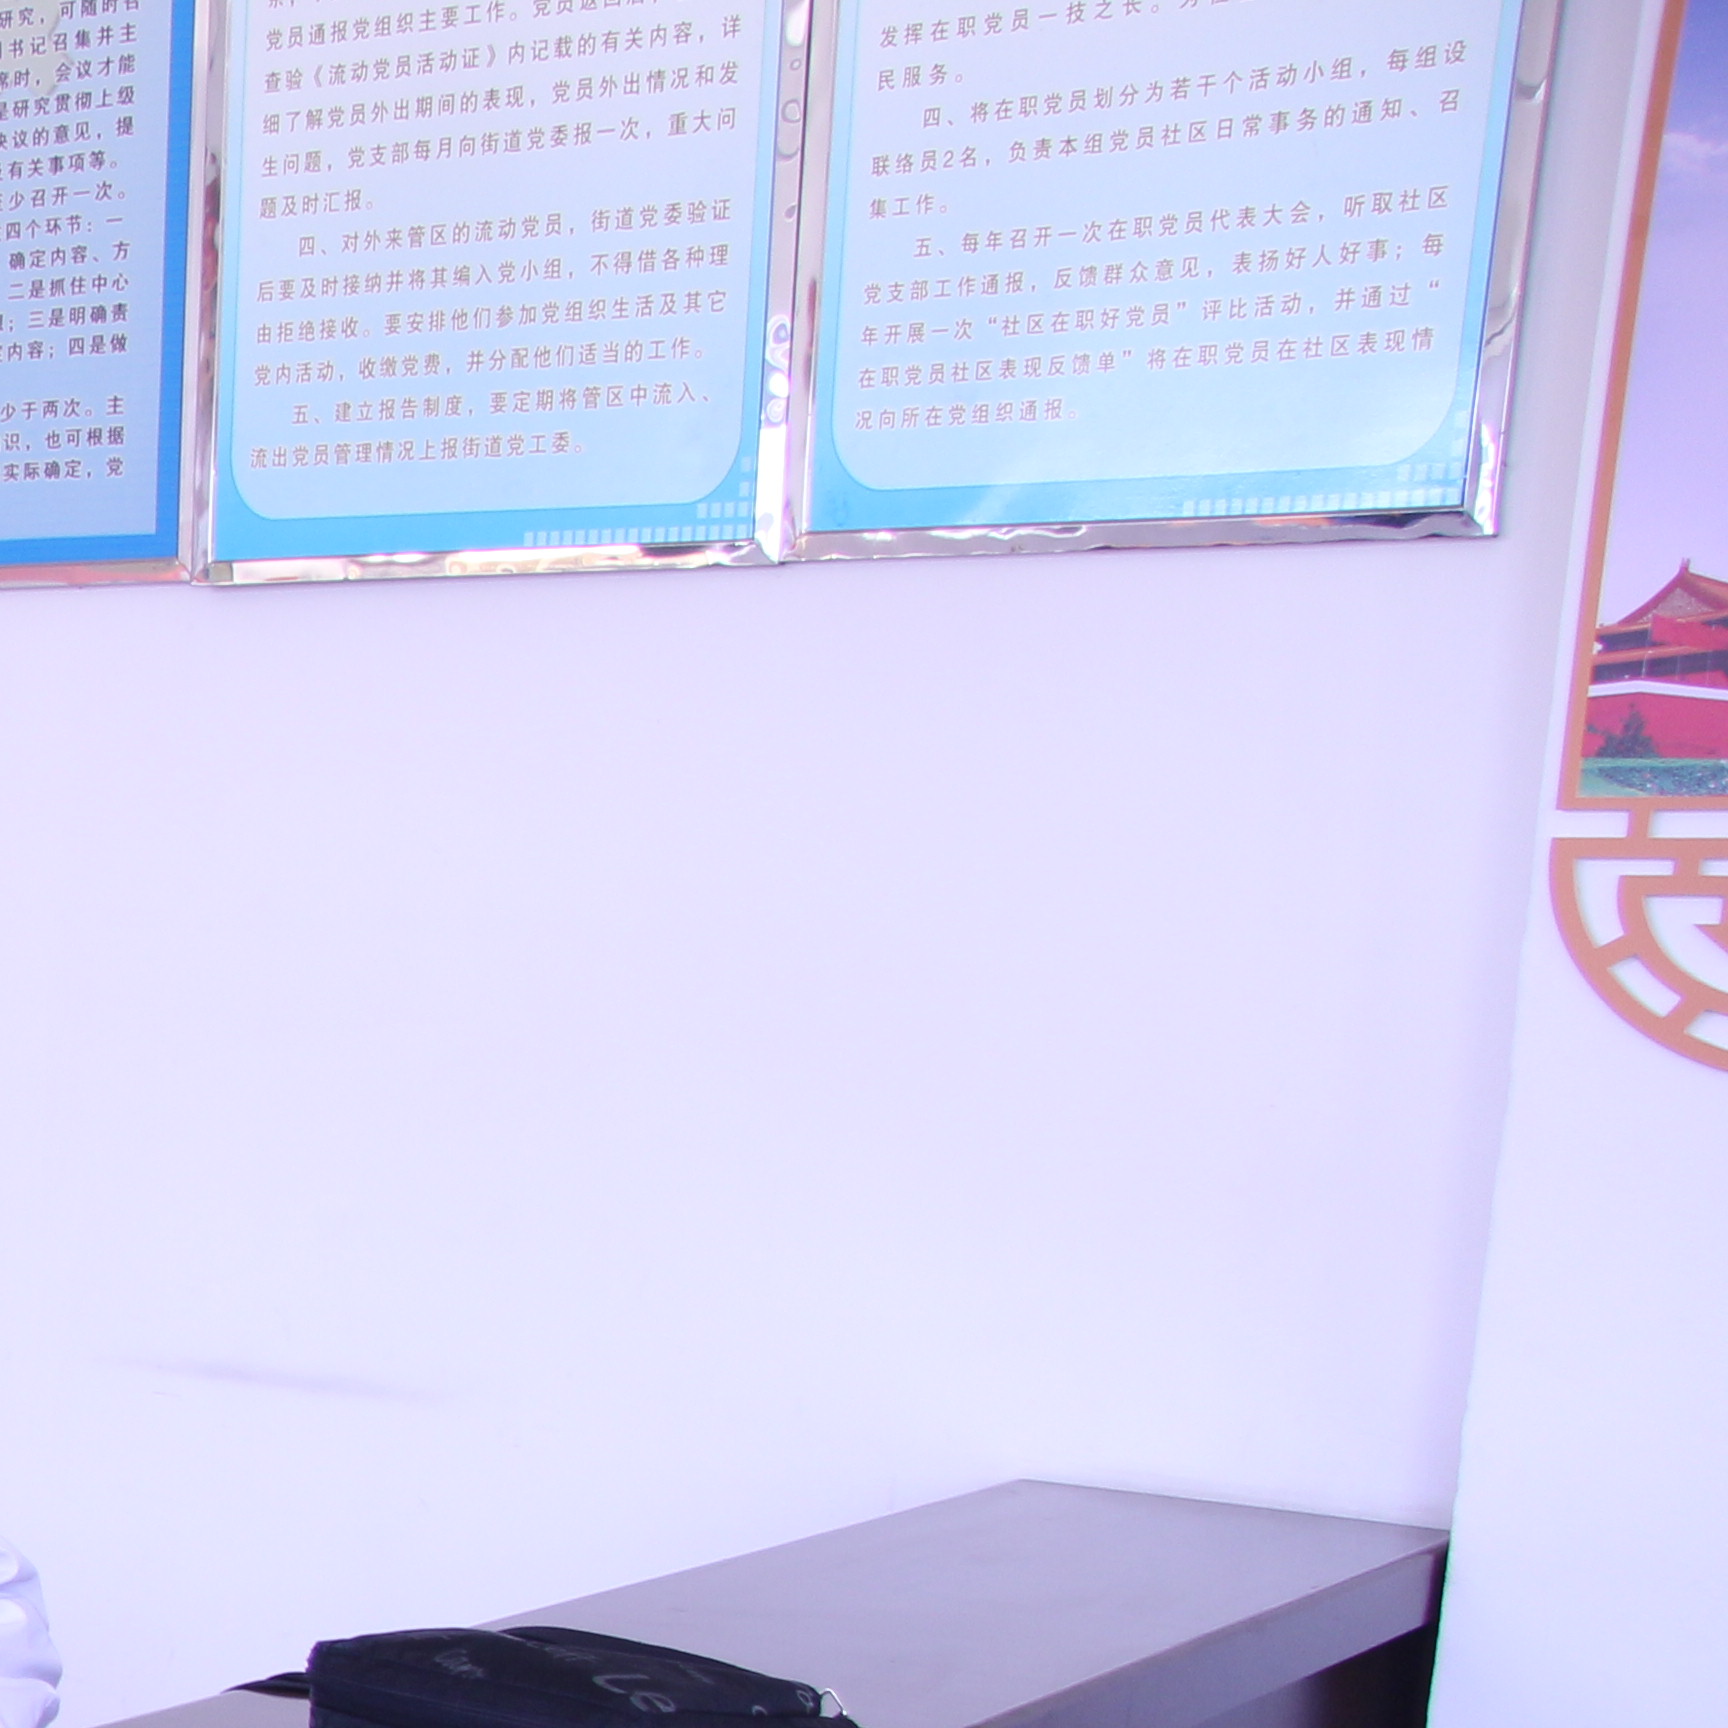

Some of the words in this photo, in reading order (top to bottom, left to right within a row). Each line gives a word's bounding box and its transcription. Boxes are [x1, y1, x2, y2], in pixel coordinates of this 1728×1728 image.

[264, 14, 742, 95] 查验《流动党员活动证》内记载的有关内容，详
[877, 66, 966, 92] 民服务。
[922, 40, 1467, 129] 四、将在职党员划分为若干个活动小组，每组设
[262, 59, 739, 136] 细了解党员外出期间的表现，党员外出情况和发
[260, 107, 737, 178] 生问题，党支部每月向街道党委报一次，重大问
[871, 89, 1462, 177] 联络员2名，负责本组党员社区日常事务的通知、召
[259, 188, 375, 220] 题及时汇报。
[297, 197, 732, 258] 四、对外来管区的流动党员，街道党委验证
[869, 194, 950, 220] 集工作。
[913, 185, 1450, 258] 五、每年召开一次在职党员代表大会，听取社区
[256, 243, 729, 303] 后要及时接纳并将其编入党小组，不得借各种理
[863, 232, 1445, 306] 党支部工作通报，反馈群众意见，表扬好人好事；每
[256, 289, 727, 345] 由拒绝接收。要安排他们参加党组织生活及其它
[253, 336, 706, 387] 党内活动，收缴党费，并分配他们适当的工作。
[291, 380, 712, 426] 五、建立报告制度，要定期将管区中流入、
[854, 400, 1079, 431] 况向所在党组织通报。
[250, 431, 586, 470] 流出党员管理情况上报街道党工委。
